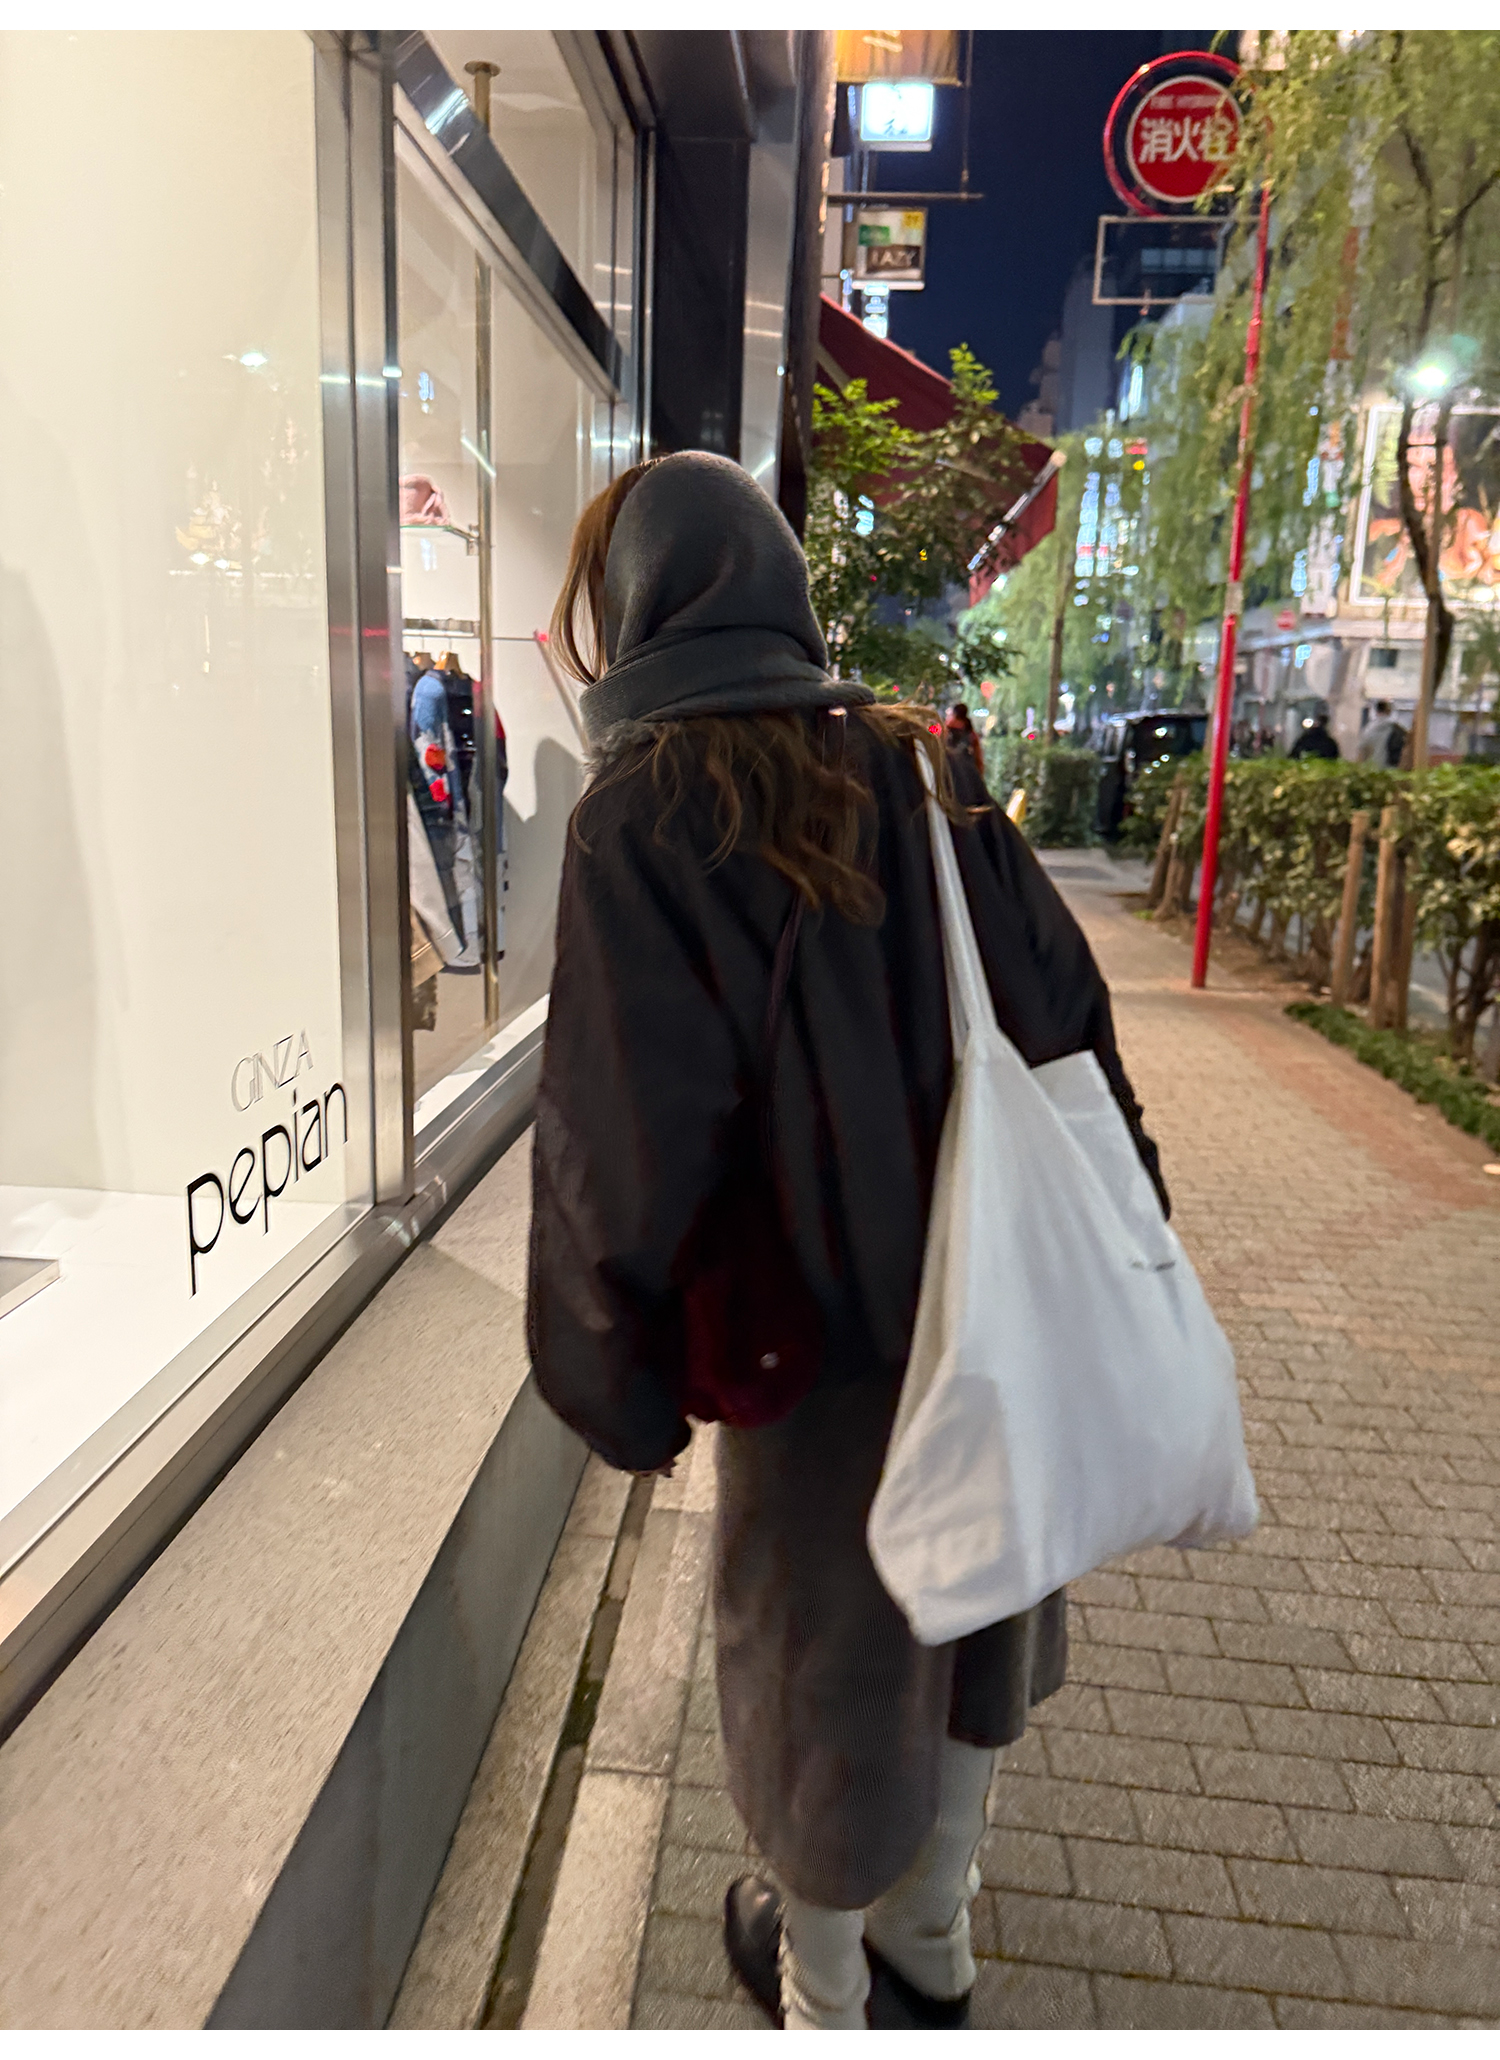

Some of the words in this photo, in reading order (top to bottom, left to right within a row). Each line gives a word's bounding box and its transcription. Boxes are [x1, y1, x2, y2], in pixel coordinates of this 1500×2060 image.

[1139, 115, 1233, 163] 消火栓
[231, 1028, 314, 1112] GINZA
[186, 1081, 348, 1299] pepian
